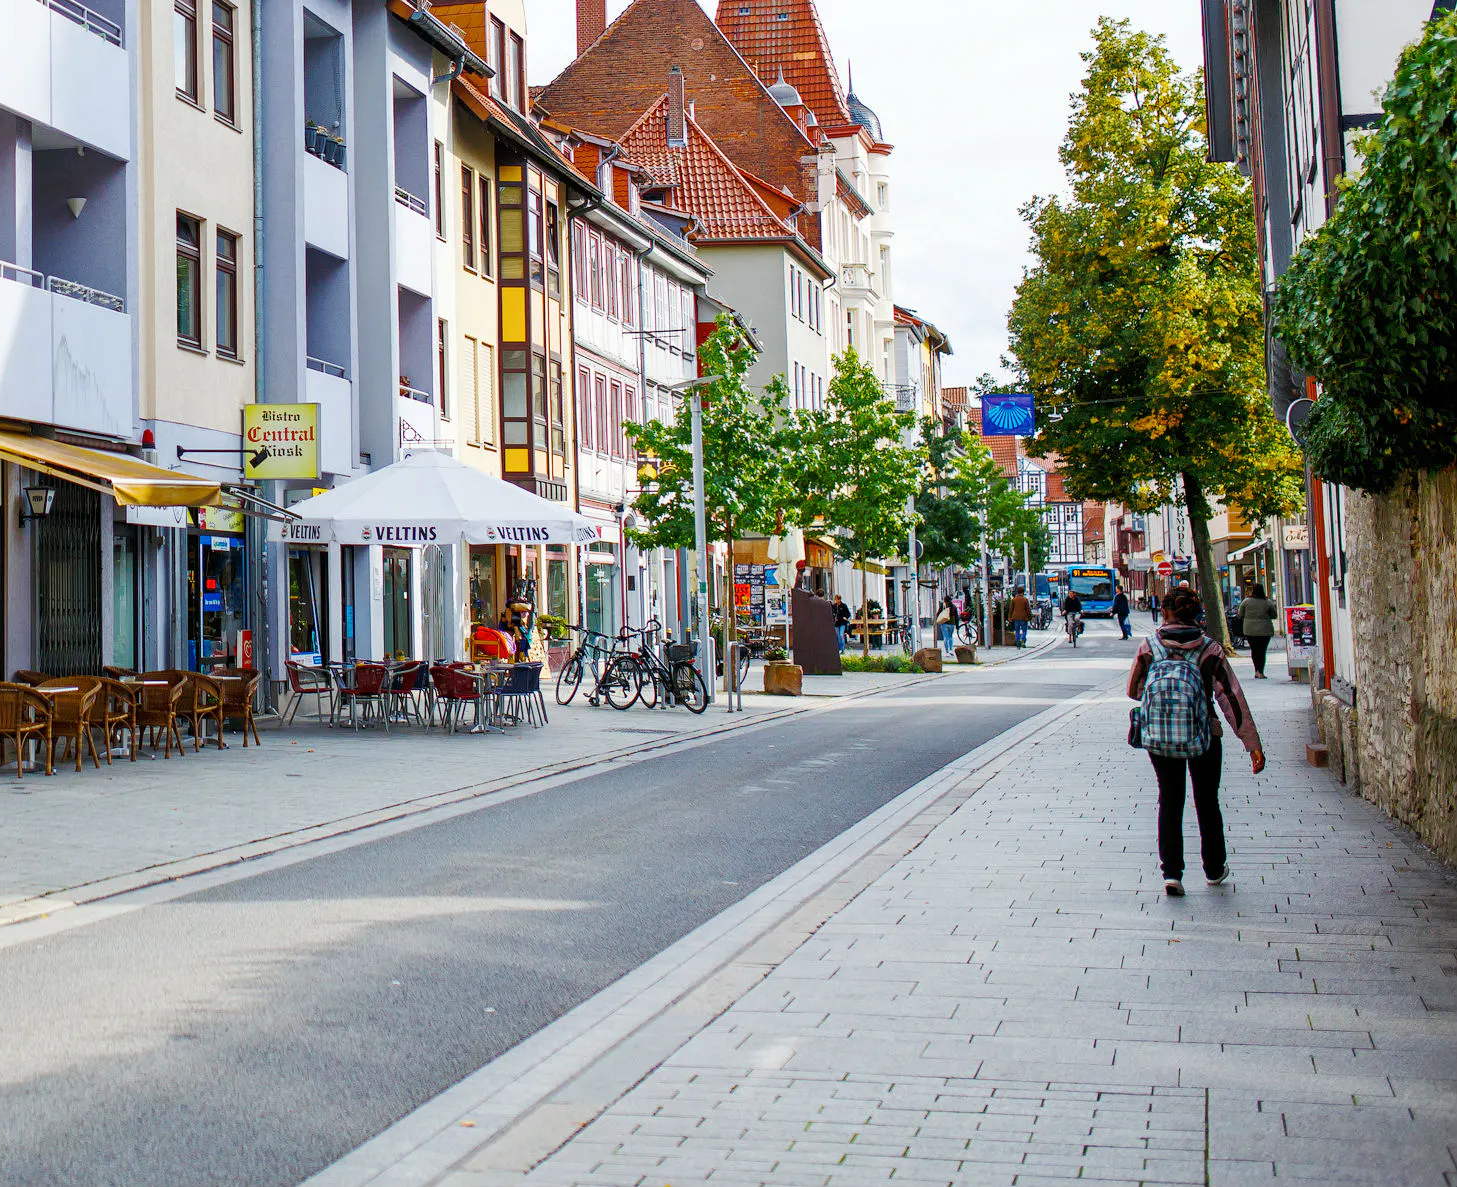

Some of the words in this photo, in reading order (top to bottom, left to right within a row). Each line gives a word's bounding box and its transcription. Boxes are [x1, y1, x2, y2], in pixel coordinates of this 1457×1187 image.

[262, 410, 300, 421] Bistro
[247, 426, 315, 442] Central
[290, 524, 321, 540] VELTINS
[375, 526, 437, 541] VELTINS
[496, 526, 550, 541] VELTINS
